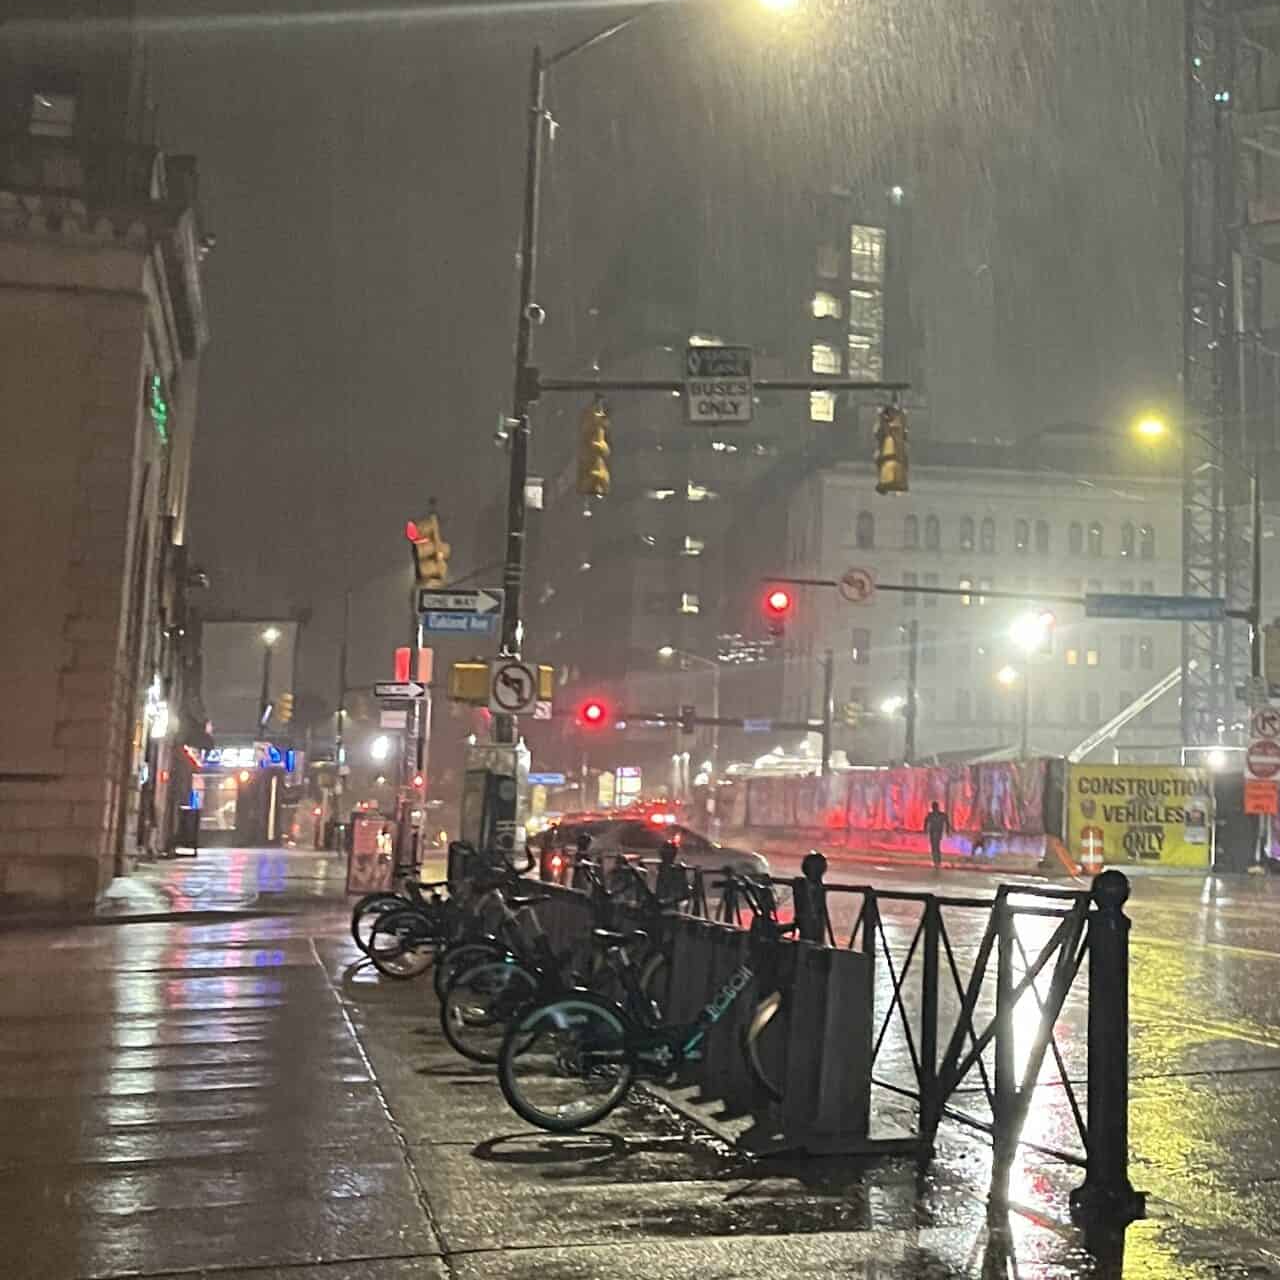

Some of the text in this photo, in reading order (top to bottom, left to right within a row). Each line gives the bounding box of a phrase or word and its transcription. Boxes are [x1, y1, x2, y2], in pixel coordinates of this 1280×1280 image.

[697, 401, 740, 416] ONLY
[1078, 775, 1211, 799] CONSTRUCTION
[1102, 804, 1186, 824] VEHICLES
[1123, 830, 1166, 852] ONLY
